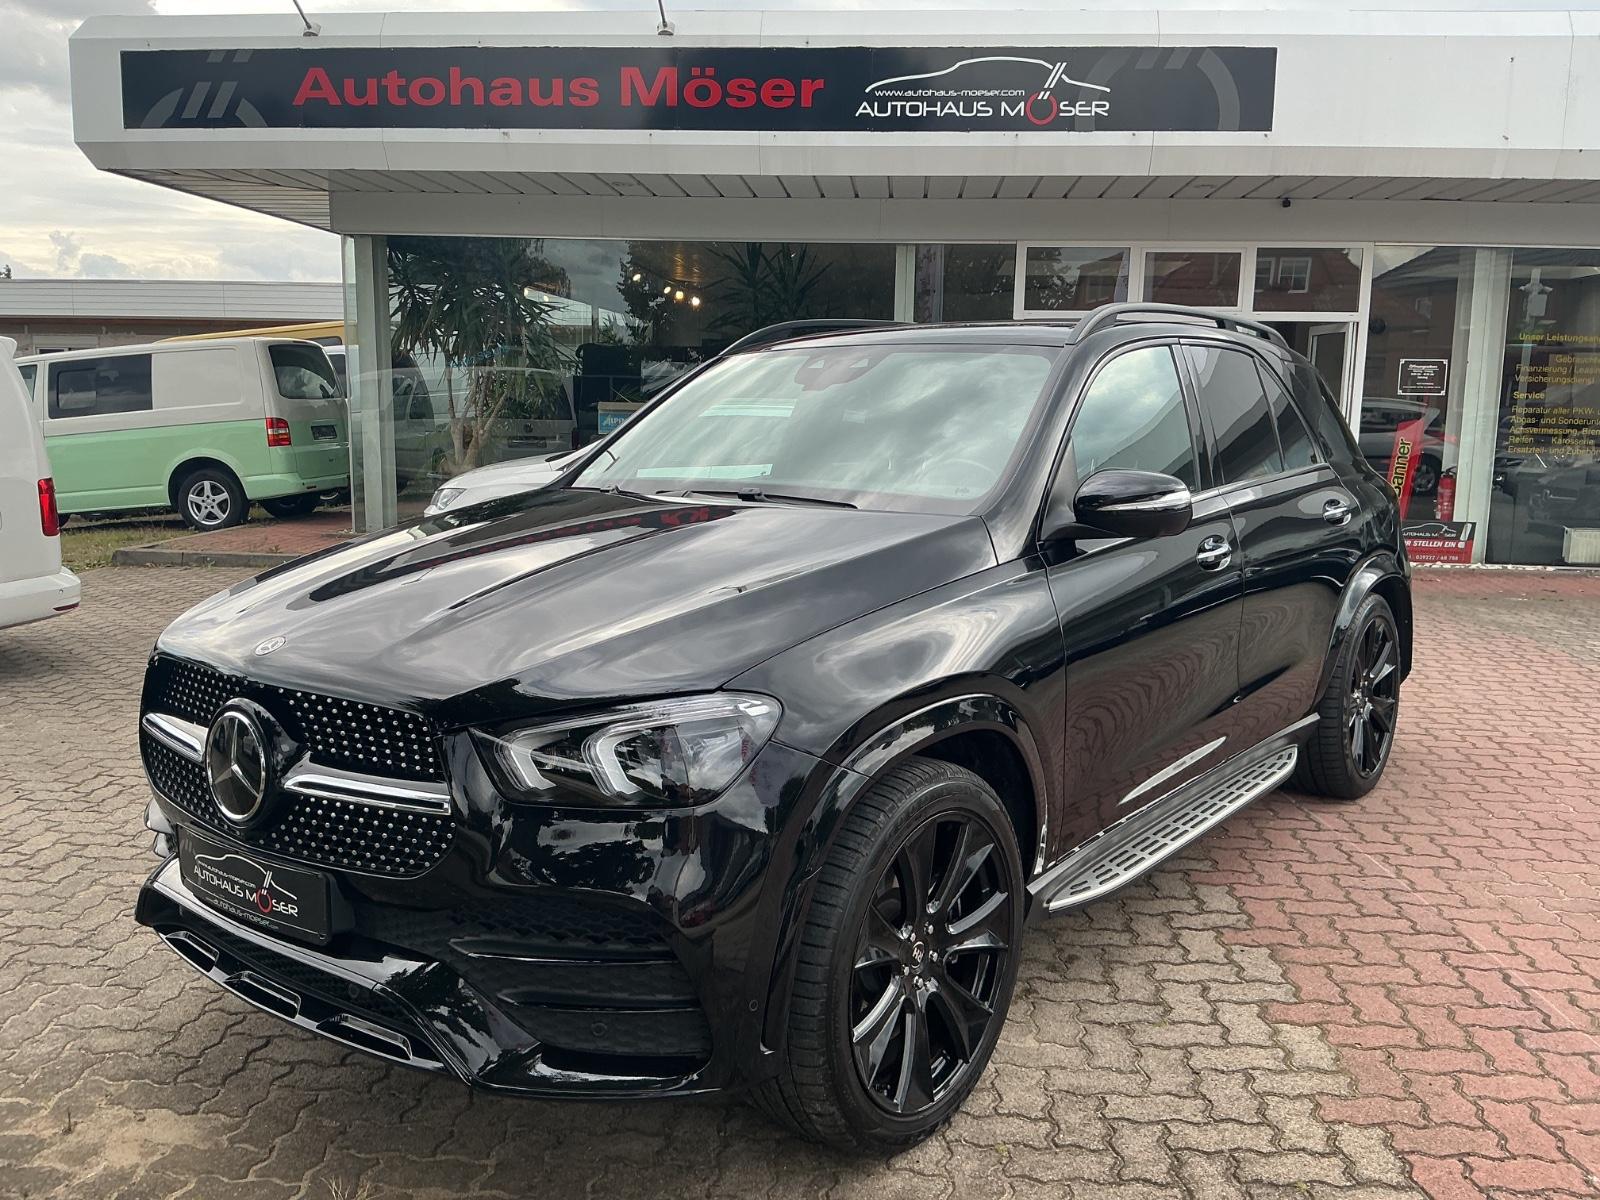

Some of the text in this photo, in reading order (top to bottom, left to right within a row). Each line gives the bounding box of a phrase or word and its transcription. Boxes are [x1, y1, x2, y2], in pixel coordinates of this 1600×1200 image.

[293, 66, 825, 109] Autohaus Möser
[875, 88, 1025, 97] www.autohaus-moeser.com
[855, 90, 1110, 126] AUTOHAUS MÖSER
[1519, 332, 1545, 341] Unser
[1512, 391, 1545, 399] Service
[1511, 405, 1551, 414] Reparatur
[1540, 417, 1556, 425] und
[1508, 435, 1534, 444] Reifen
[1551, 437, 1594, 446] Karosserie
[194, 865, 299, 918] AUTOHAUS MÖSER
